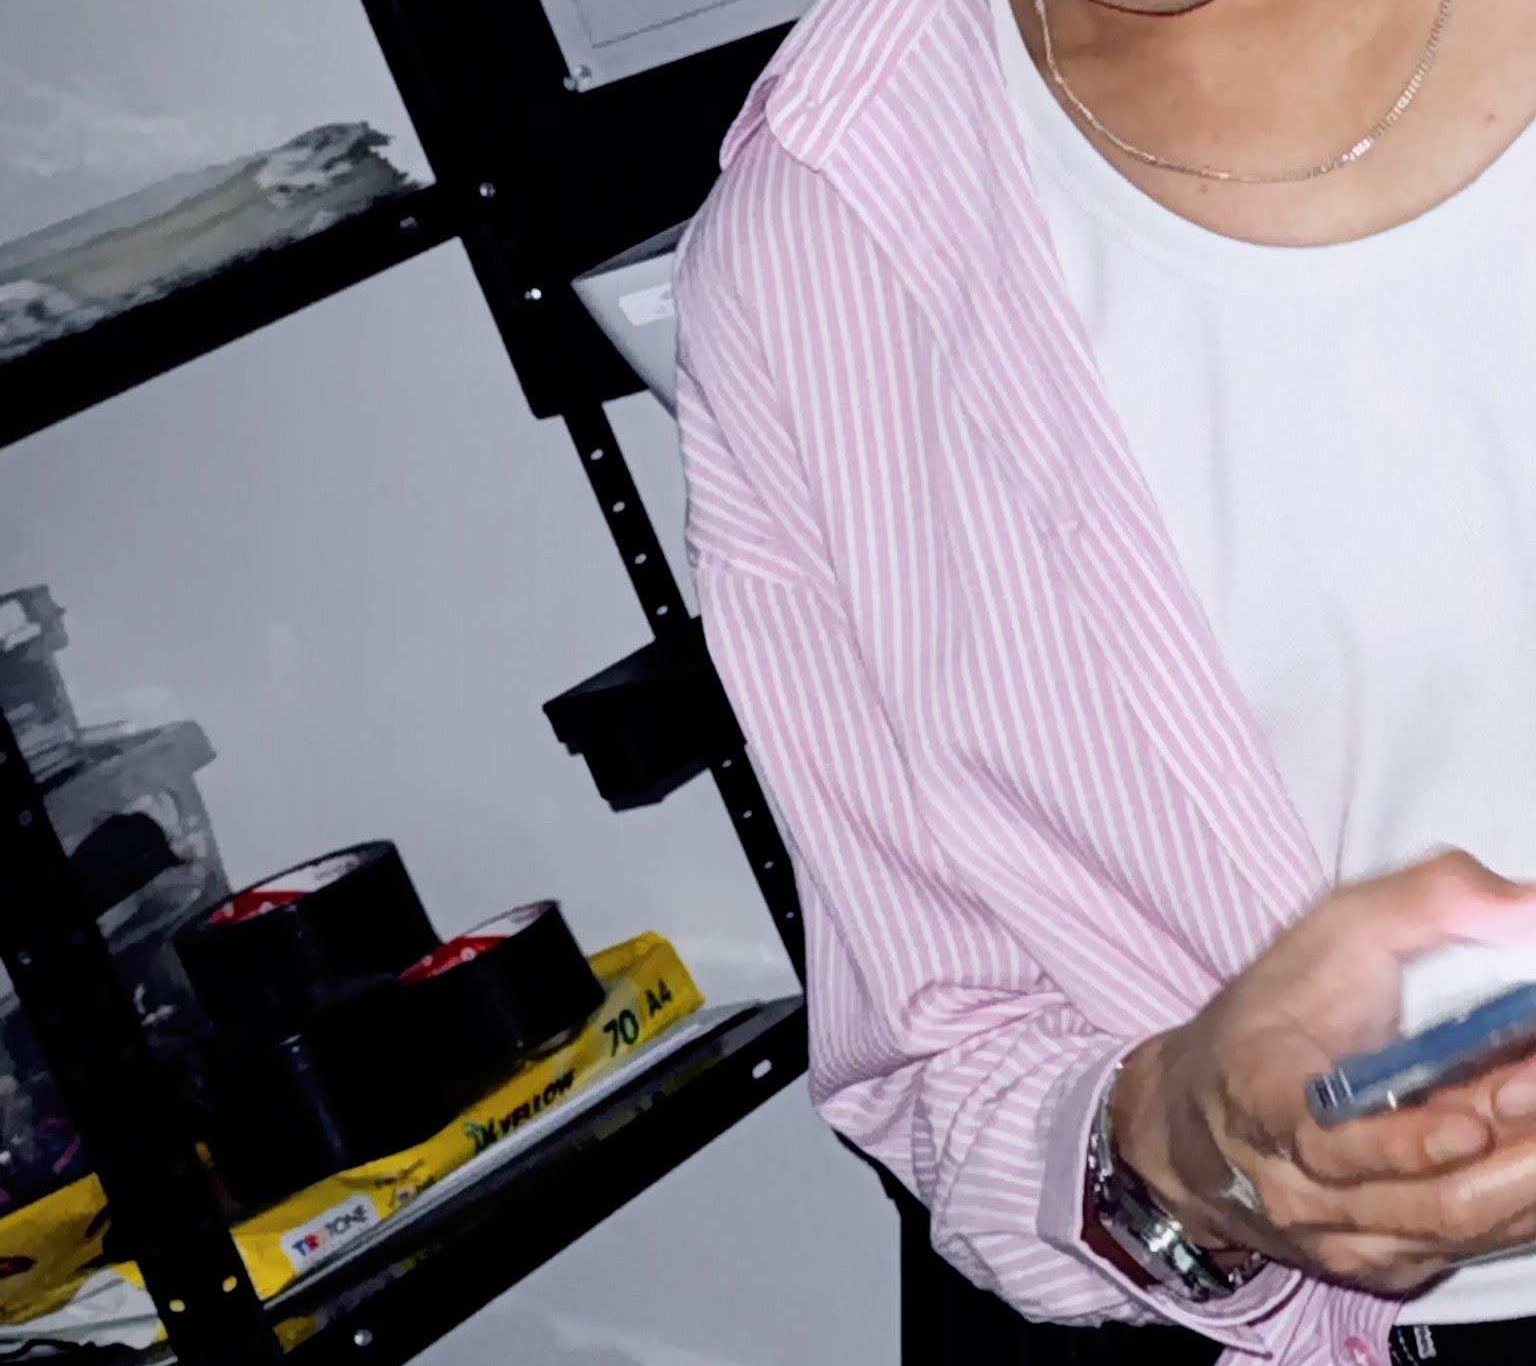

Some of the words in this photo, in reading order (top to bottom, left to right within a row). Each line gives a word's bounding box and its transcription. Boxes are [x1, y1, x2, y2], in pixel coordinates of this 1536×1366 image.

[603, 1009, 639, 1057] 70
[645, 979, 673, 1018] A4
[500, 1069, 576, 1134] YELLOW
